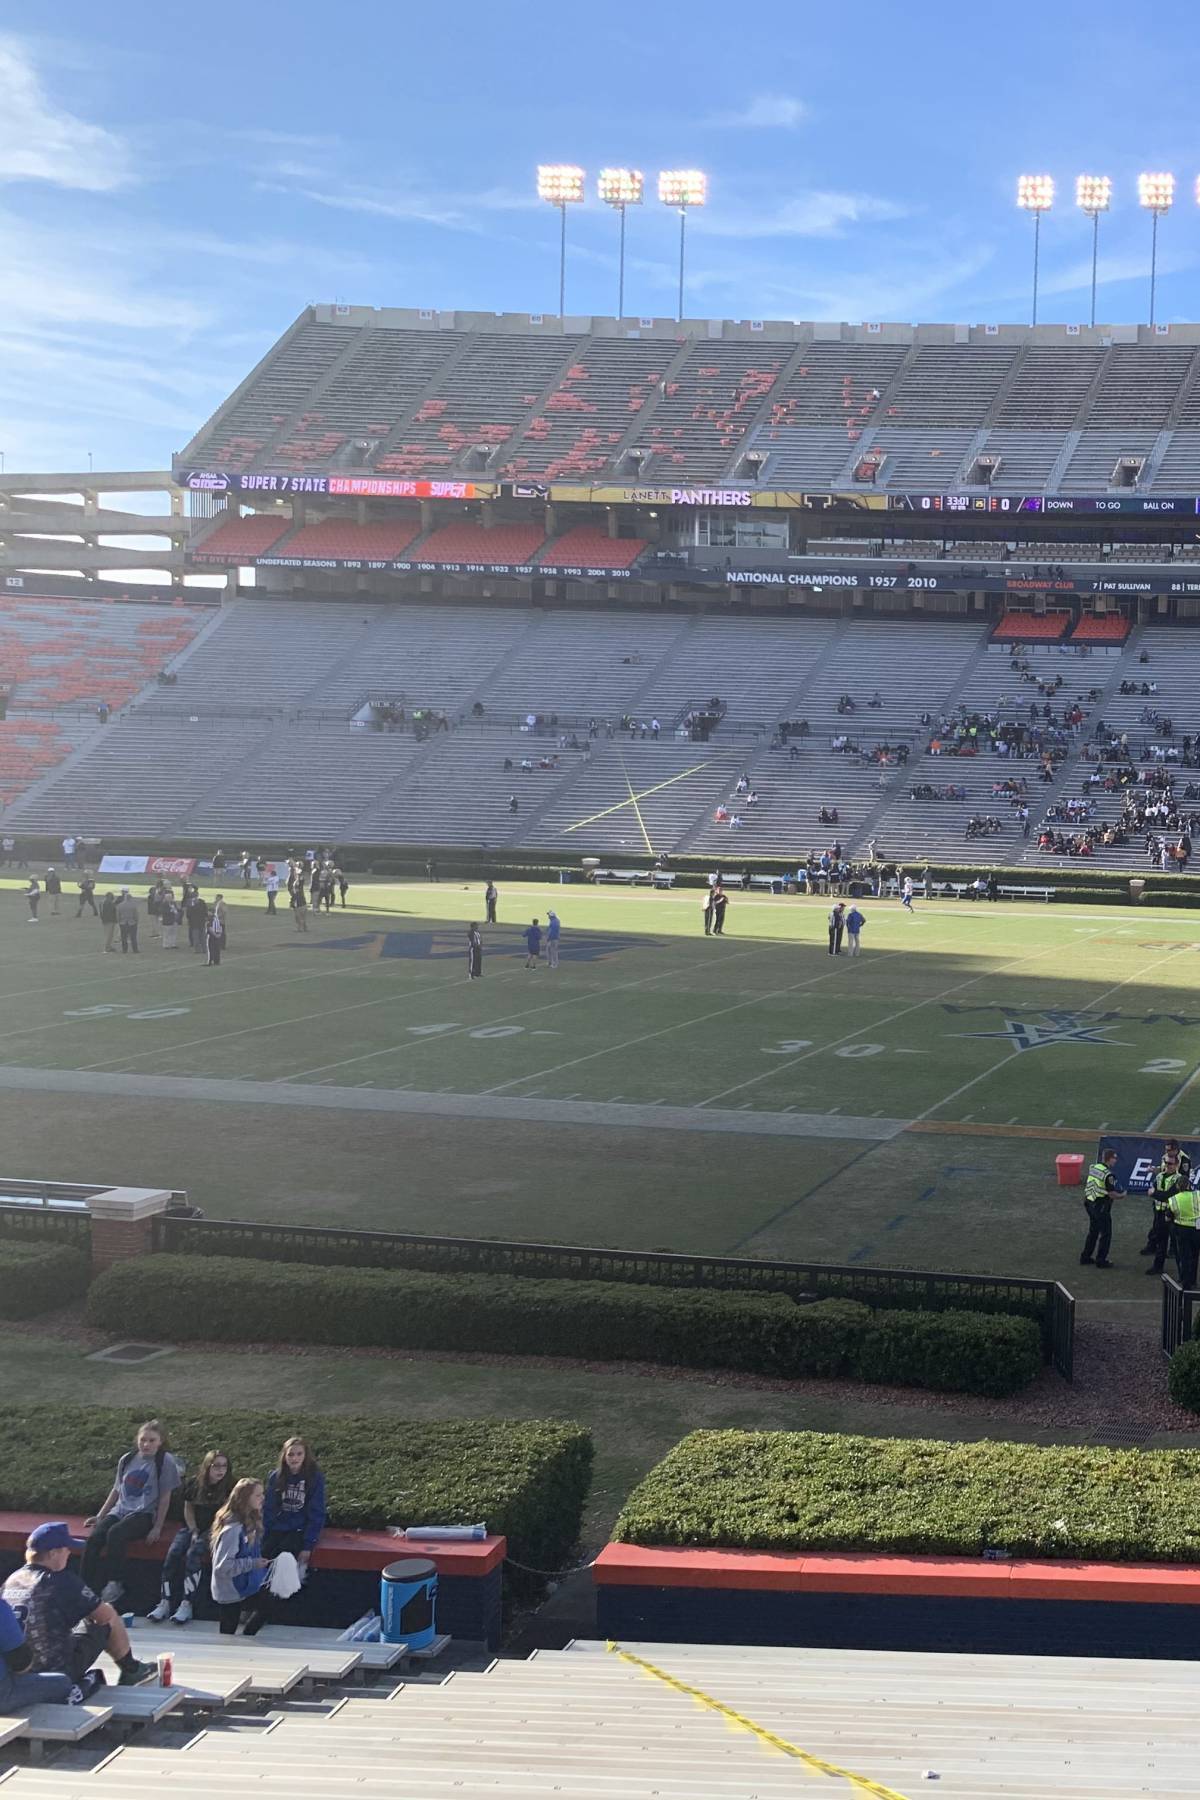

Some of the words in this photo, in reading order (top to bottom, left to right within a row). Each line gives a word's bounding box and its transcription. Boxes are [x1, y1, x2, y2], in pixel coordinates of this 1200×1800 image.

[241, 475, 277, 492] SUPER
[280, 477, 289, 493] 7
[291, 478, 327, 494] STATE
[329, 480, 416, 497] CHAMPIONSHIPS
[623, 488, 667, 501] LANETT
[671, 489, 751, 506] PANTHERS
[946, 496, 969, 506] 33:01
[921, 498, 930, 510] 0
[1001, 498, 1010, 511] 0
[1047, 501, 1073, 510] DOWN
[1095, 501, 1106, 510] TO
[1107, 501, 1121, 511] GO
[1143, 501, 1159, 511] BALL
[1160, 502, 1174, 511] ON
[256, 558, 302, 568] UNDEFEATED
[303, 560, 336, 569] SEASONS
[392, 563, 410, 571] 1900
[466, 565, 484, 573] 1914
[611, 569, 630, 577] 2010
[727, 572, 785, 585] NATIONAL
[788, 574, 858, 587] CHAMPIONS
[869, 577, 896, 588] 1957
[907, 577, 937, 589] 2010
[1006, 580, 1054, 590] BROADWAY
[1055, 581, 1074, 590] CLUB
[1103, 583, 1116, 591] PAT
[1117, 583, 1150, 592] SULLIVAN
